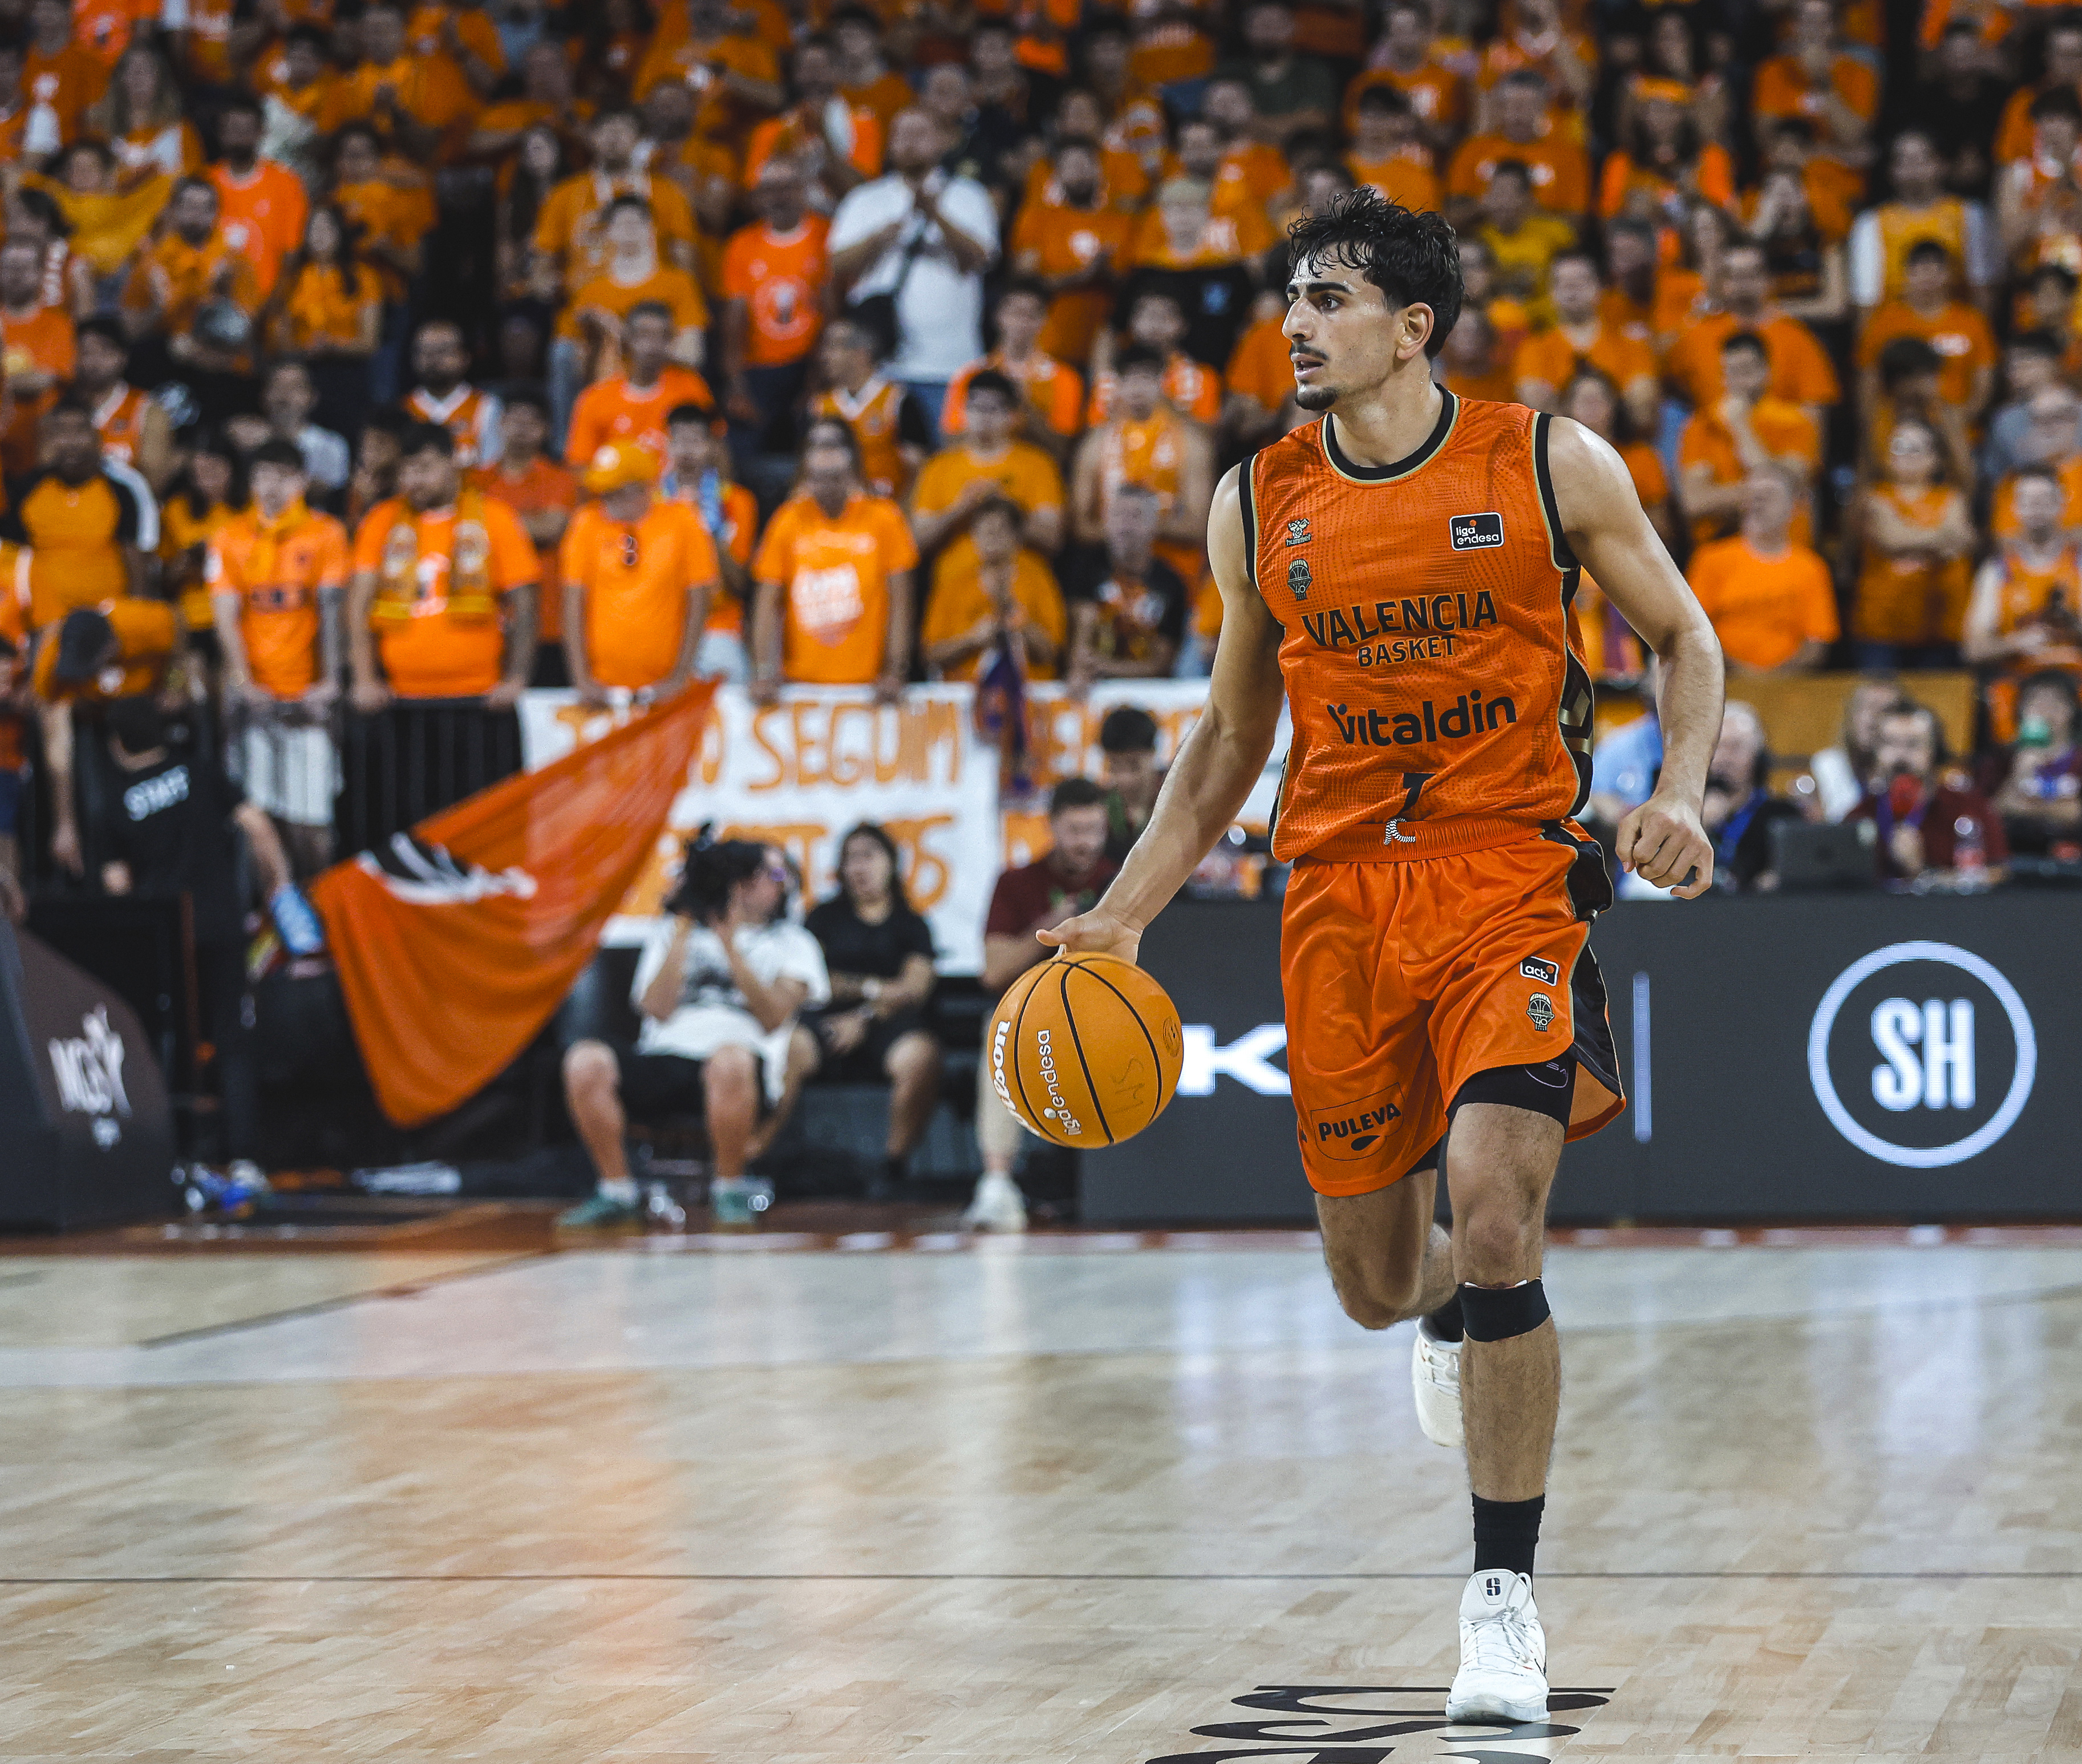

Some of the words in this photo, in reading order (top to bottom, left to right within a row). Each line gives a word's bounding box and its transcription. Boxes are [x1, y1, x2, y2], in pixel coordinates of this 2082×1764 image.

[1456, 526, 1476, 537] liga
[1457, 533, 1499, 545] endesa
[1302, 590, 1498, 646] VALENCIA
[1358, 634, 1456, 667] BASKET
[1525, 965, 1549, 980] acb
[1535, 1015, 1548, 1026] 40
[1038, 1029, 1066, 1108] endesa
[1871, 998, 1975, 1111] SH
[1318, 1102, 1401, 1142] PULEVA
